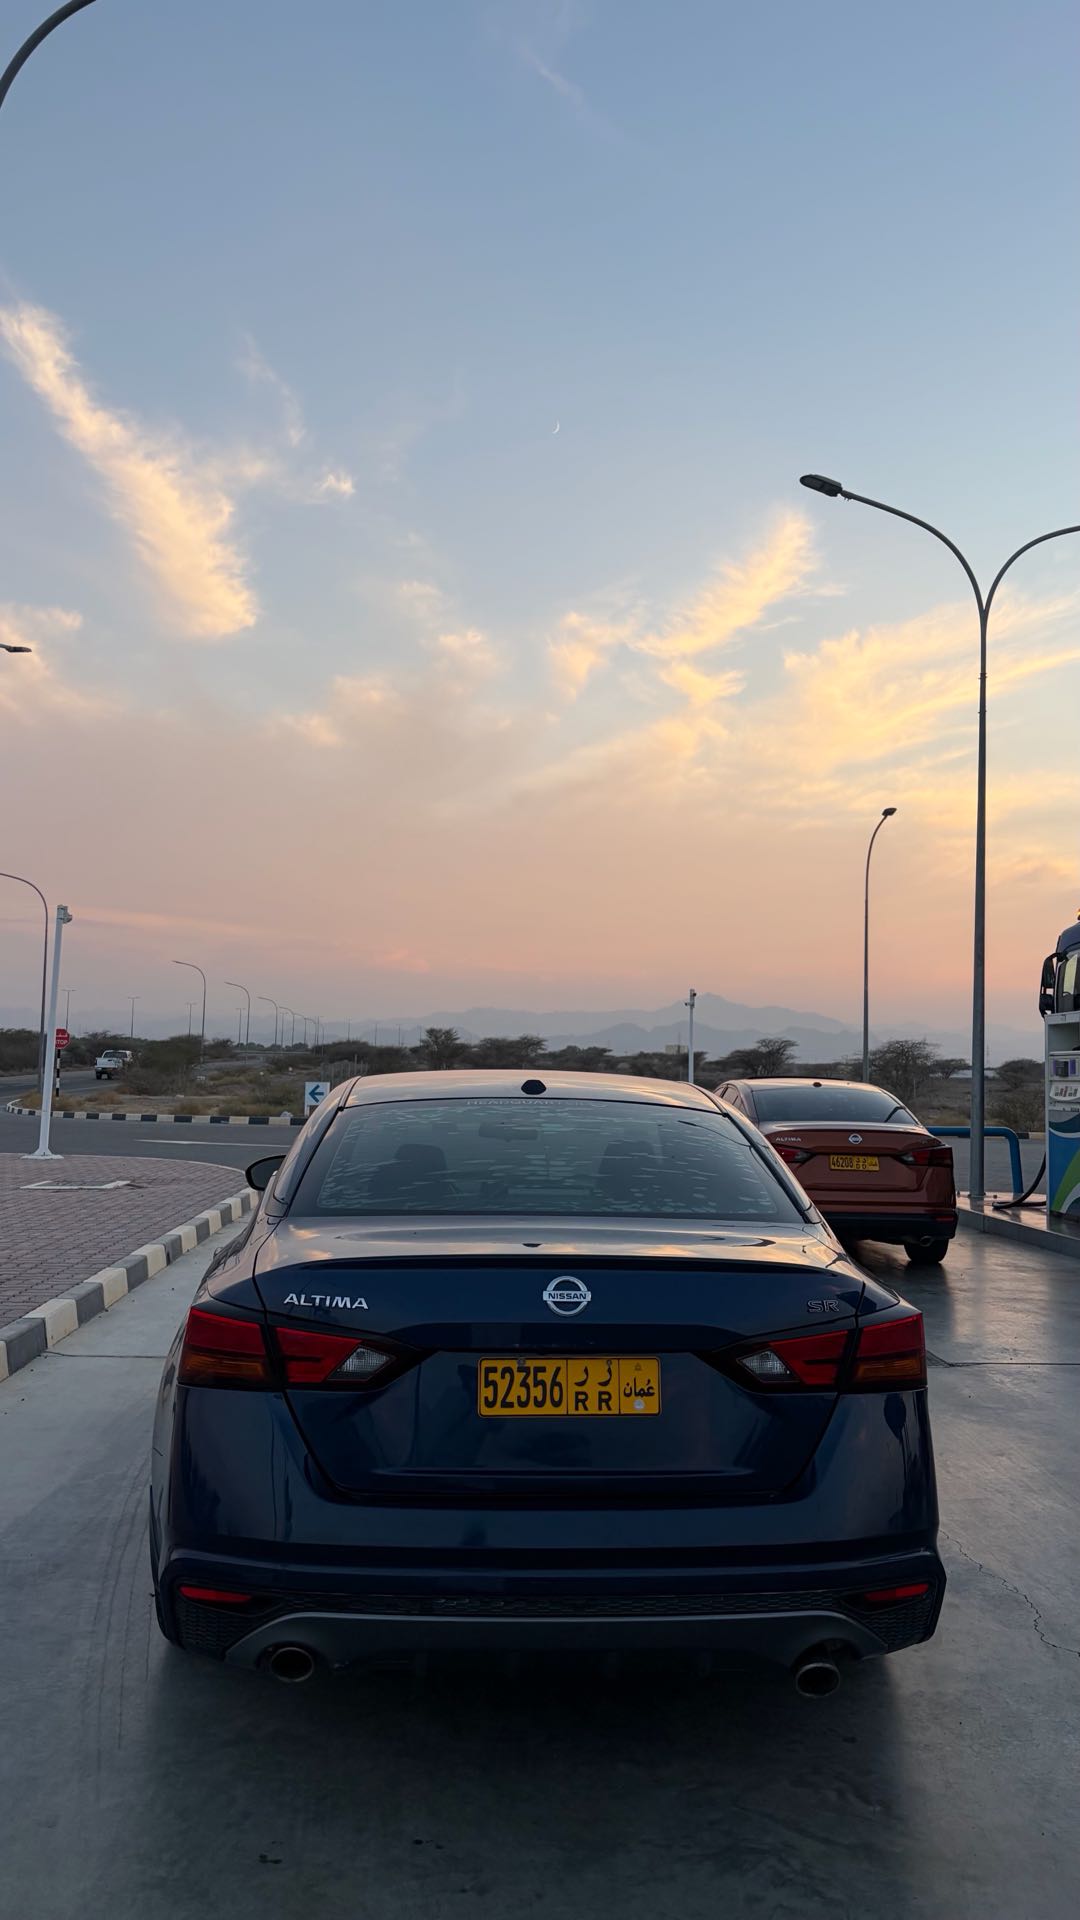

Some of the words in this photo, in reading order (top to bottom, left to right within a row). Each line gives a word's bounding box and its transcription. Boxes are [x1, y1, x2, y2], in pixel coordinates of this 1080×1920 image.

[283, 1293, 369, 1310] ALTIMA
[548, 1292, 587, 1300] NISSAN
[807, 1299, 840, 1312] SR
[483, 1366, 564, 1409] 52356
